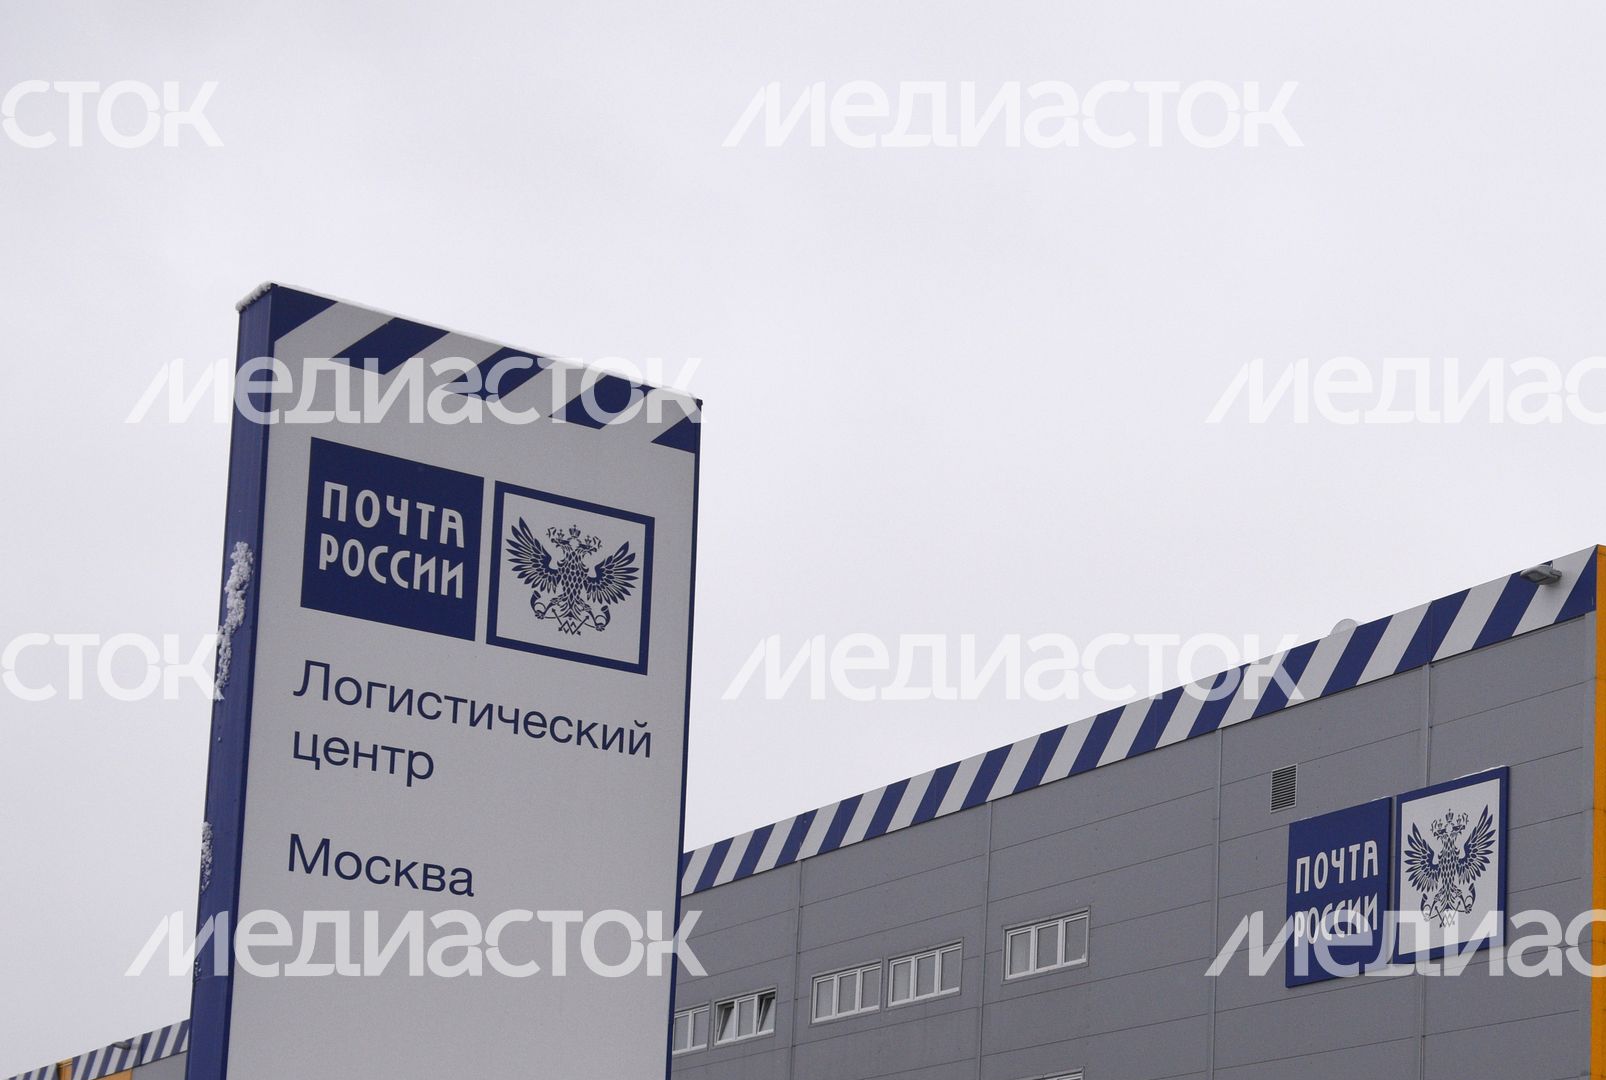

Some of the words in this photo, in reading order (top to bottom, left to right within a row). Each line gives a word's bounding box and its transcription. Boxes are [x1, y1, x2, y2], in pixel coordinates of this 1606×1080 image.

[322, 480, 465, 549] ПОЧТА
[318, 532, 464, 599] РОССИИ
[292, 659, 653, 758] Логистический
[292, 730, 434, 787] центр
[288, 833, 475, 897] Москва
[1295, 840, 1379, 894] ПОЧТА
[1294, 892, 1378, 948] РОССИИ
